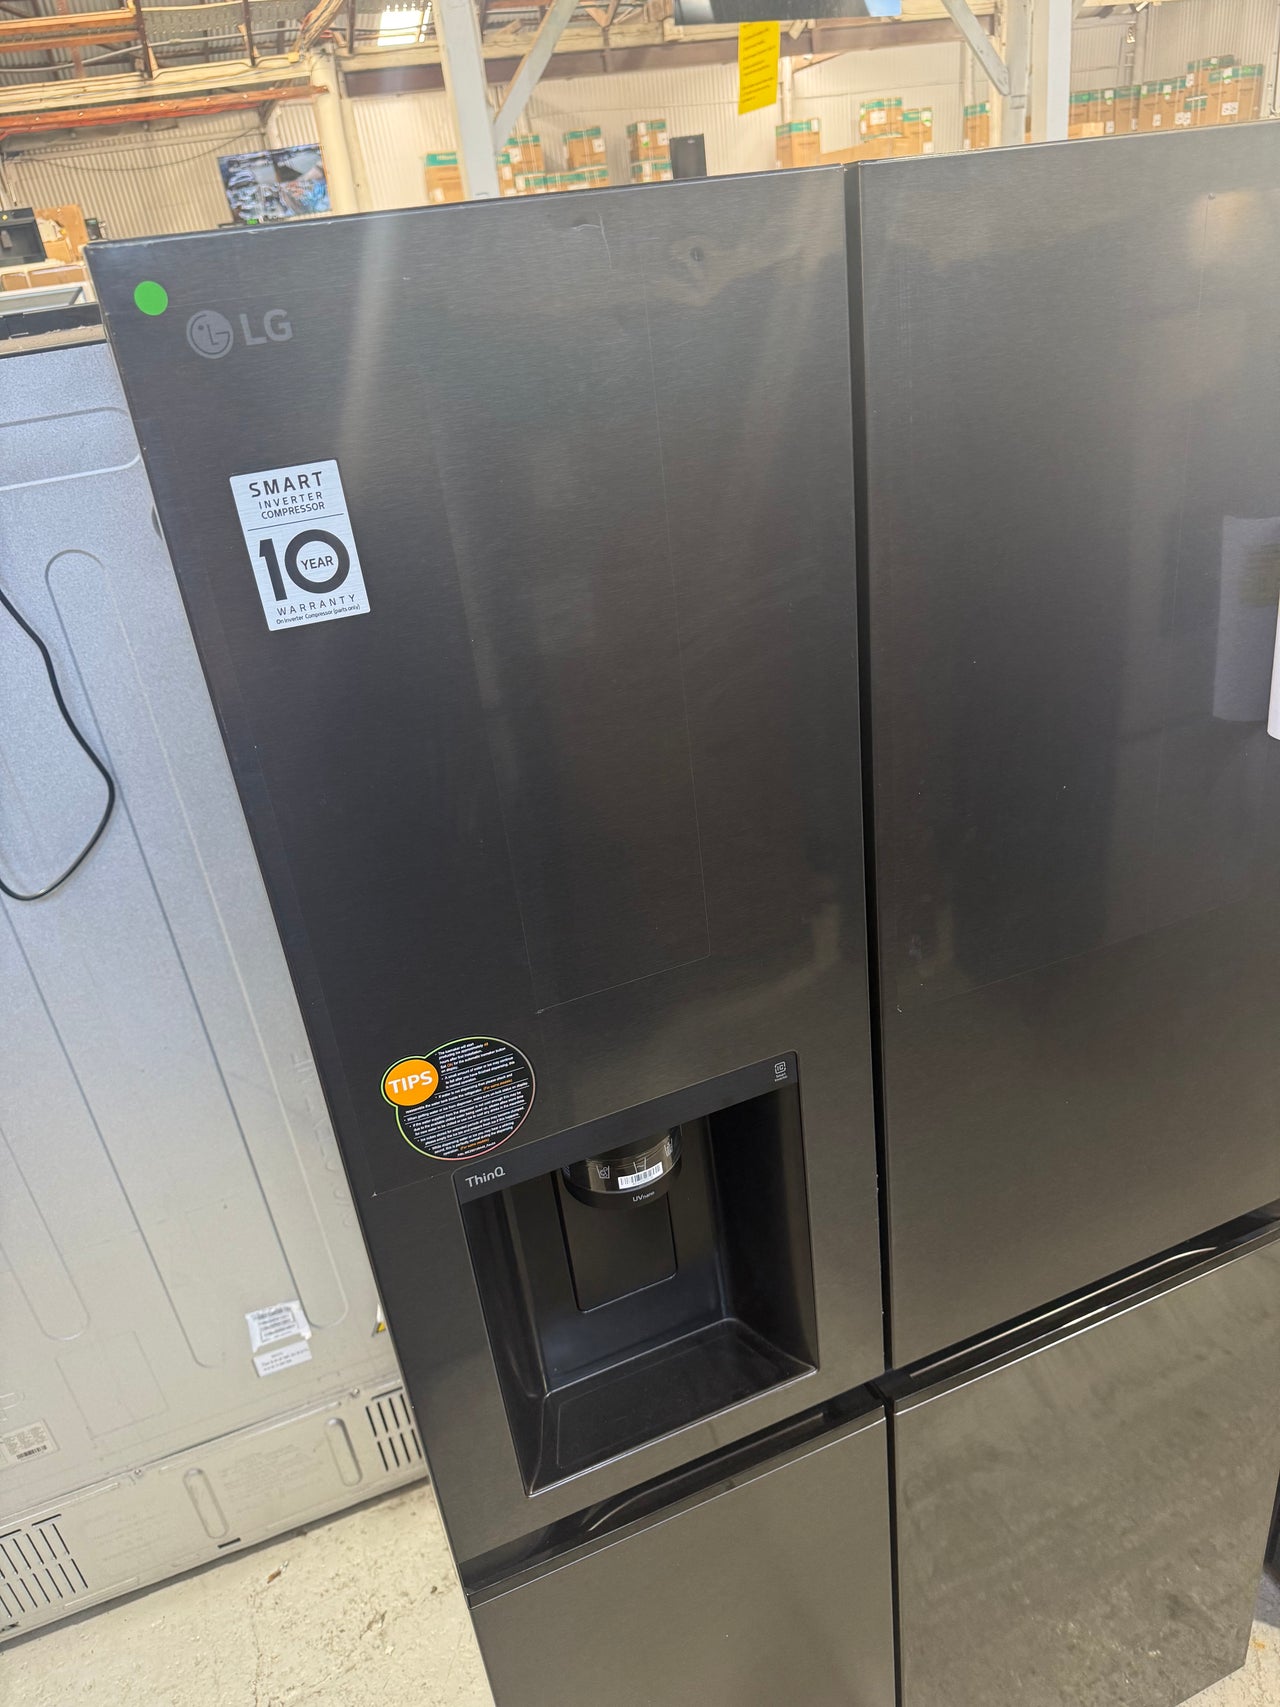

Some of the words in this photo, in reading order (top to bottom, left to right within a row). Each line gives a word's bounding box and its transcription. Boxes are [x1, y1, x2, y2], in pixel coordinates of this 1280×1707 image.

[240, 308, 293, 346] LG
[249, 471, 322, 498] SMART
[259, 491, 323, 509] INVERTER
[261, 501, 325, 520] COMPRESSOR
[259, 529, 350, 601] 10
[301, 555, 334, 571] YEAR
[276, 594, 355, 616] WARRANTY
[283, 615, 304, 623] Inverter
[305, 610, 333, 620] Compressor
[388, 1070, 433, 1094] TIPS
[465, 1166, 506, 1188] ThinQ
